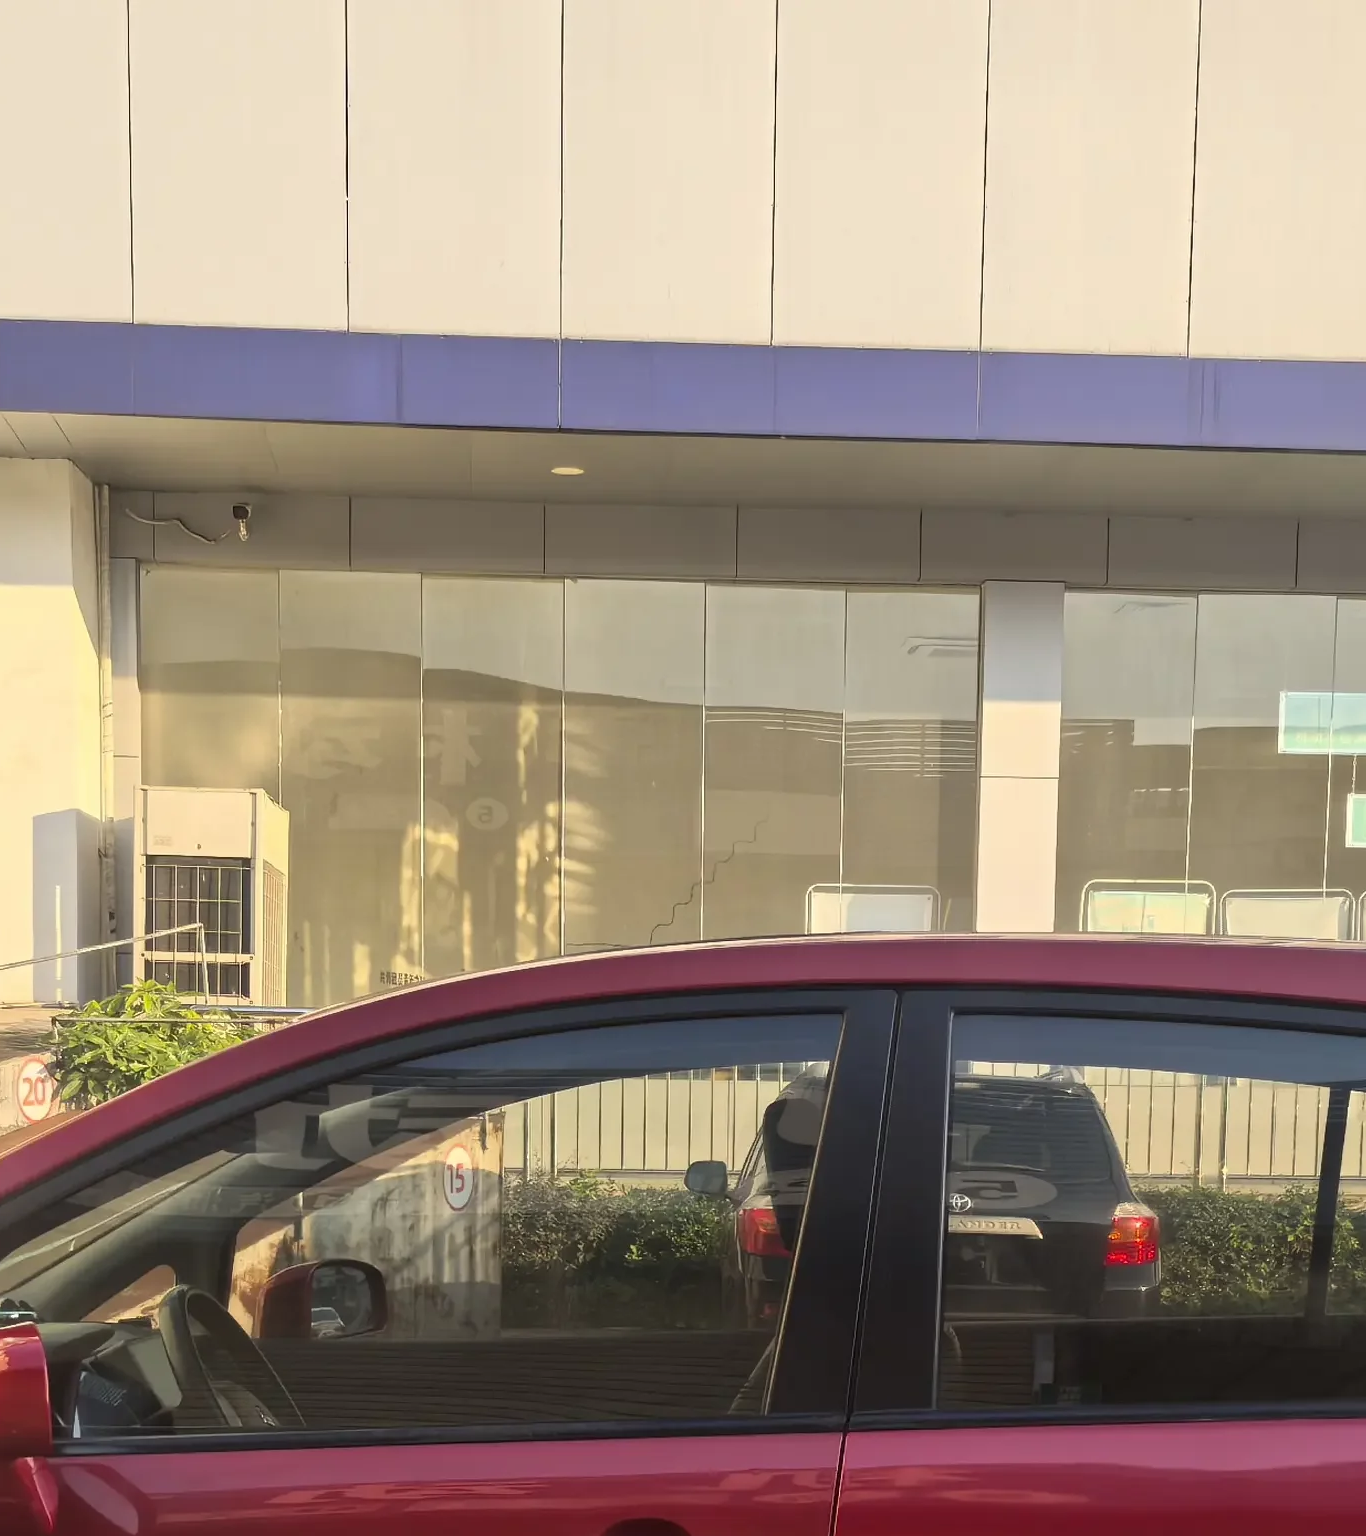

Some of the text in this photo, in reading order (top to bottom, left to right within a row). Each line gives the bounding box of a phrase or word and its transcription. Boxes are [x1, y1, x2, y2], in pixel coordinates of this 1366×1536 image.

[21, 1075, 47, 1107] 20
[445, 1162, 466, 1195] 15
[950, 1218, 1022, 1231] ANDER
